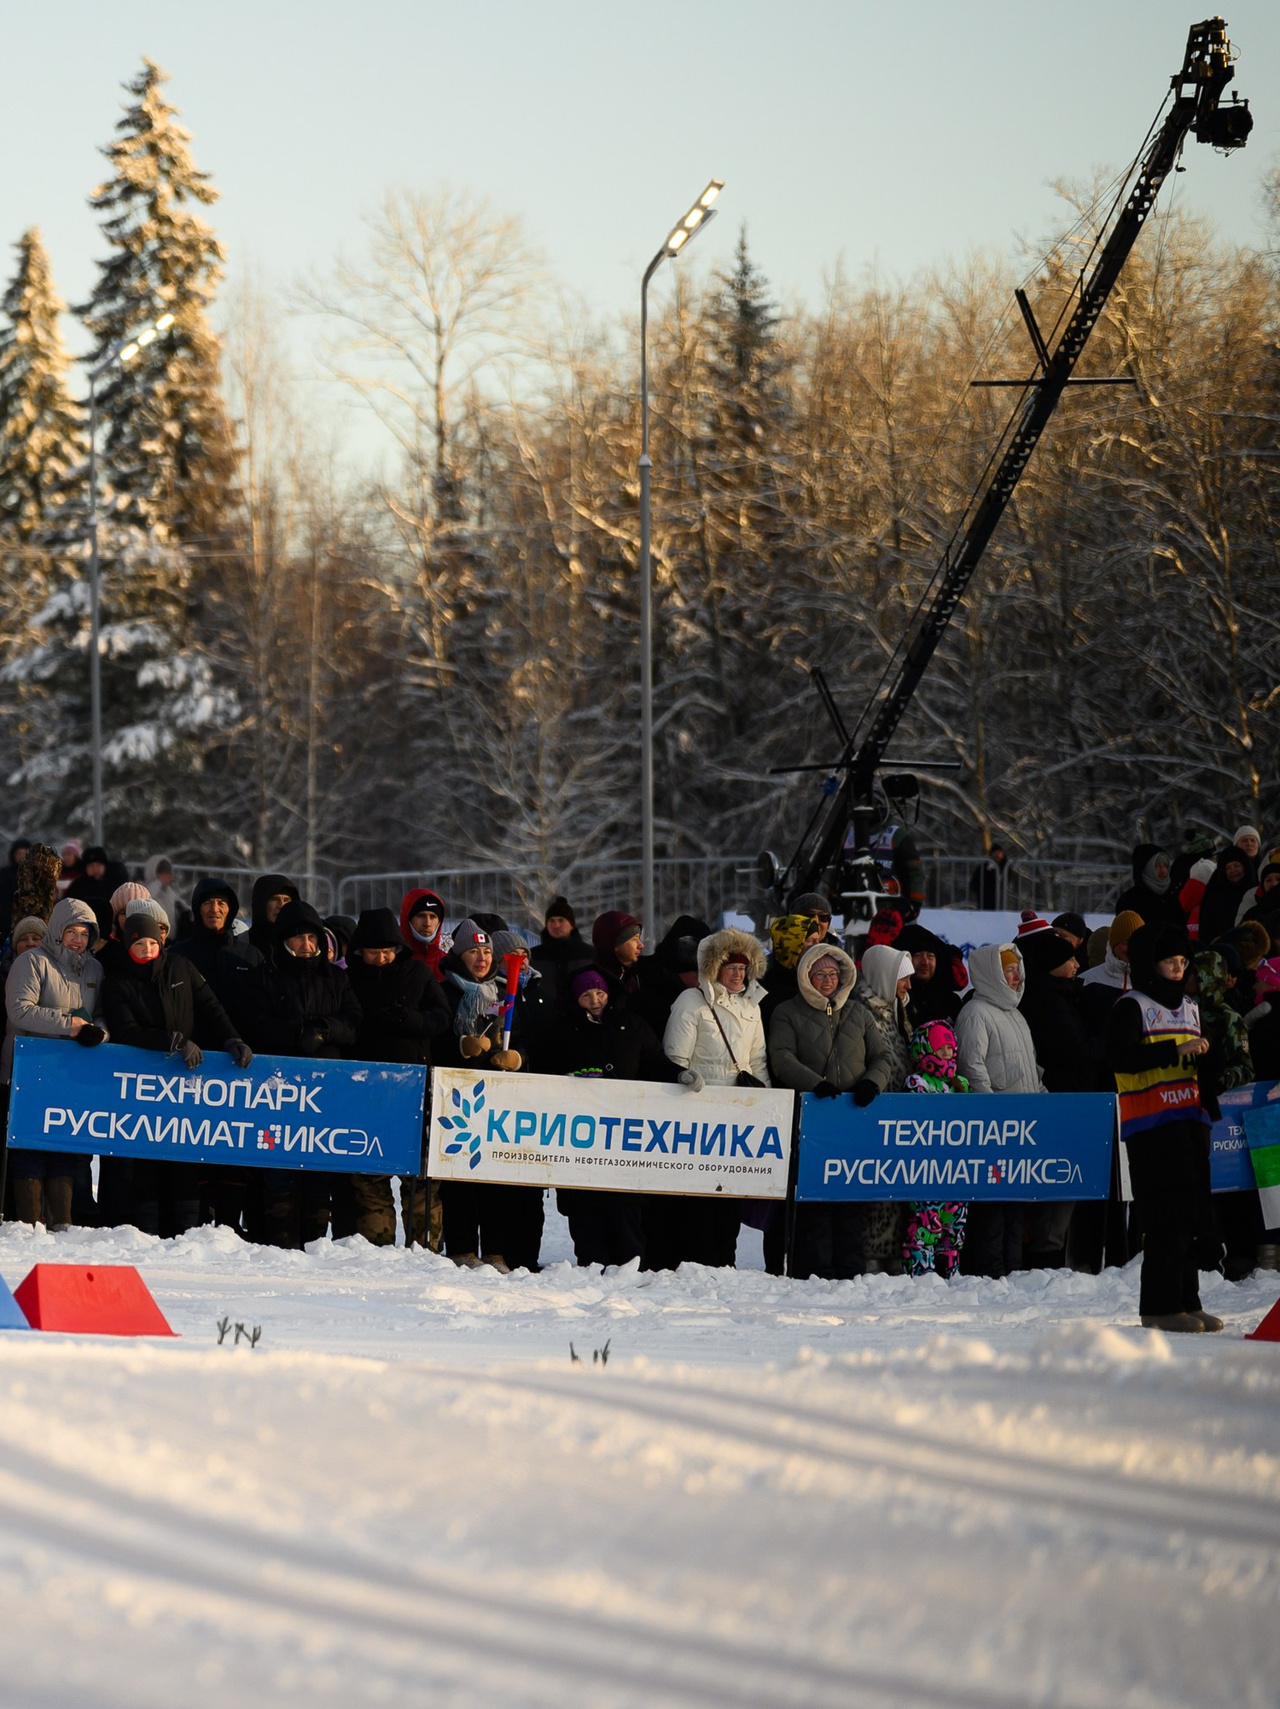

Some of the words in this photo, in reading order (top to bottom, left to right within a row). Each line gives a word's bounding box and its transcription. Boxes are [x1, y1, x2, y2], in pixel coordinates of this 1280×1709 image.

[113, 1071, 322, 1113] ТЕХНОПАРК
[43, 1107, 254, 1148] РУСКЛИМАТ
[486, 1108, 784, 1160] КРИОТЕХНИКА
[877, 1119, 1038, 1146] ТЕХНОПАРК
[491, 1151, 571, 1164] ПРОИЗВОДИТЕЛЬ
[574, 1156, 694, 1171] НЕФТЕГАЗОХИМИЧЕСКОГО
[698, 1163, 773, 1175] ОБОРУДОВАНИЯ
[823, 1158, 986, 1184] РУСКЛИМАТ
